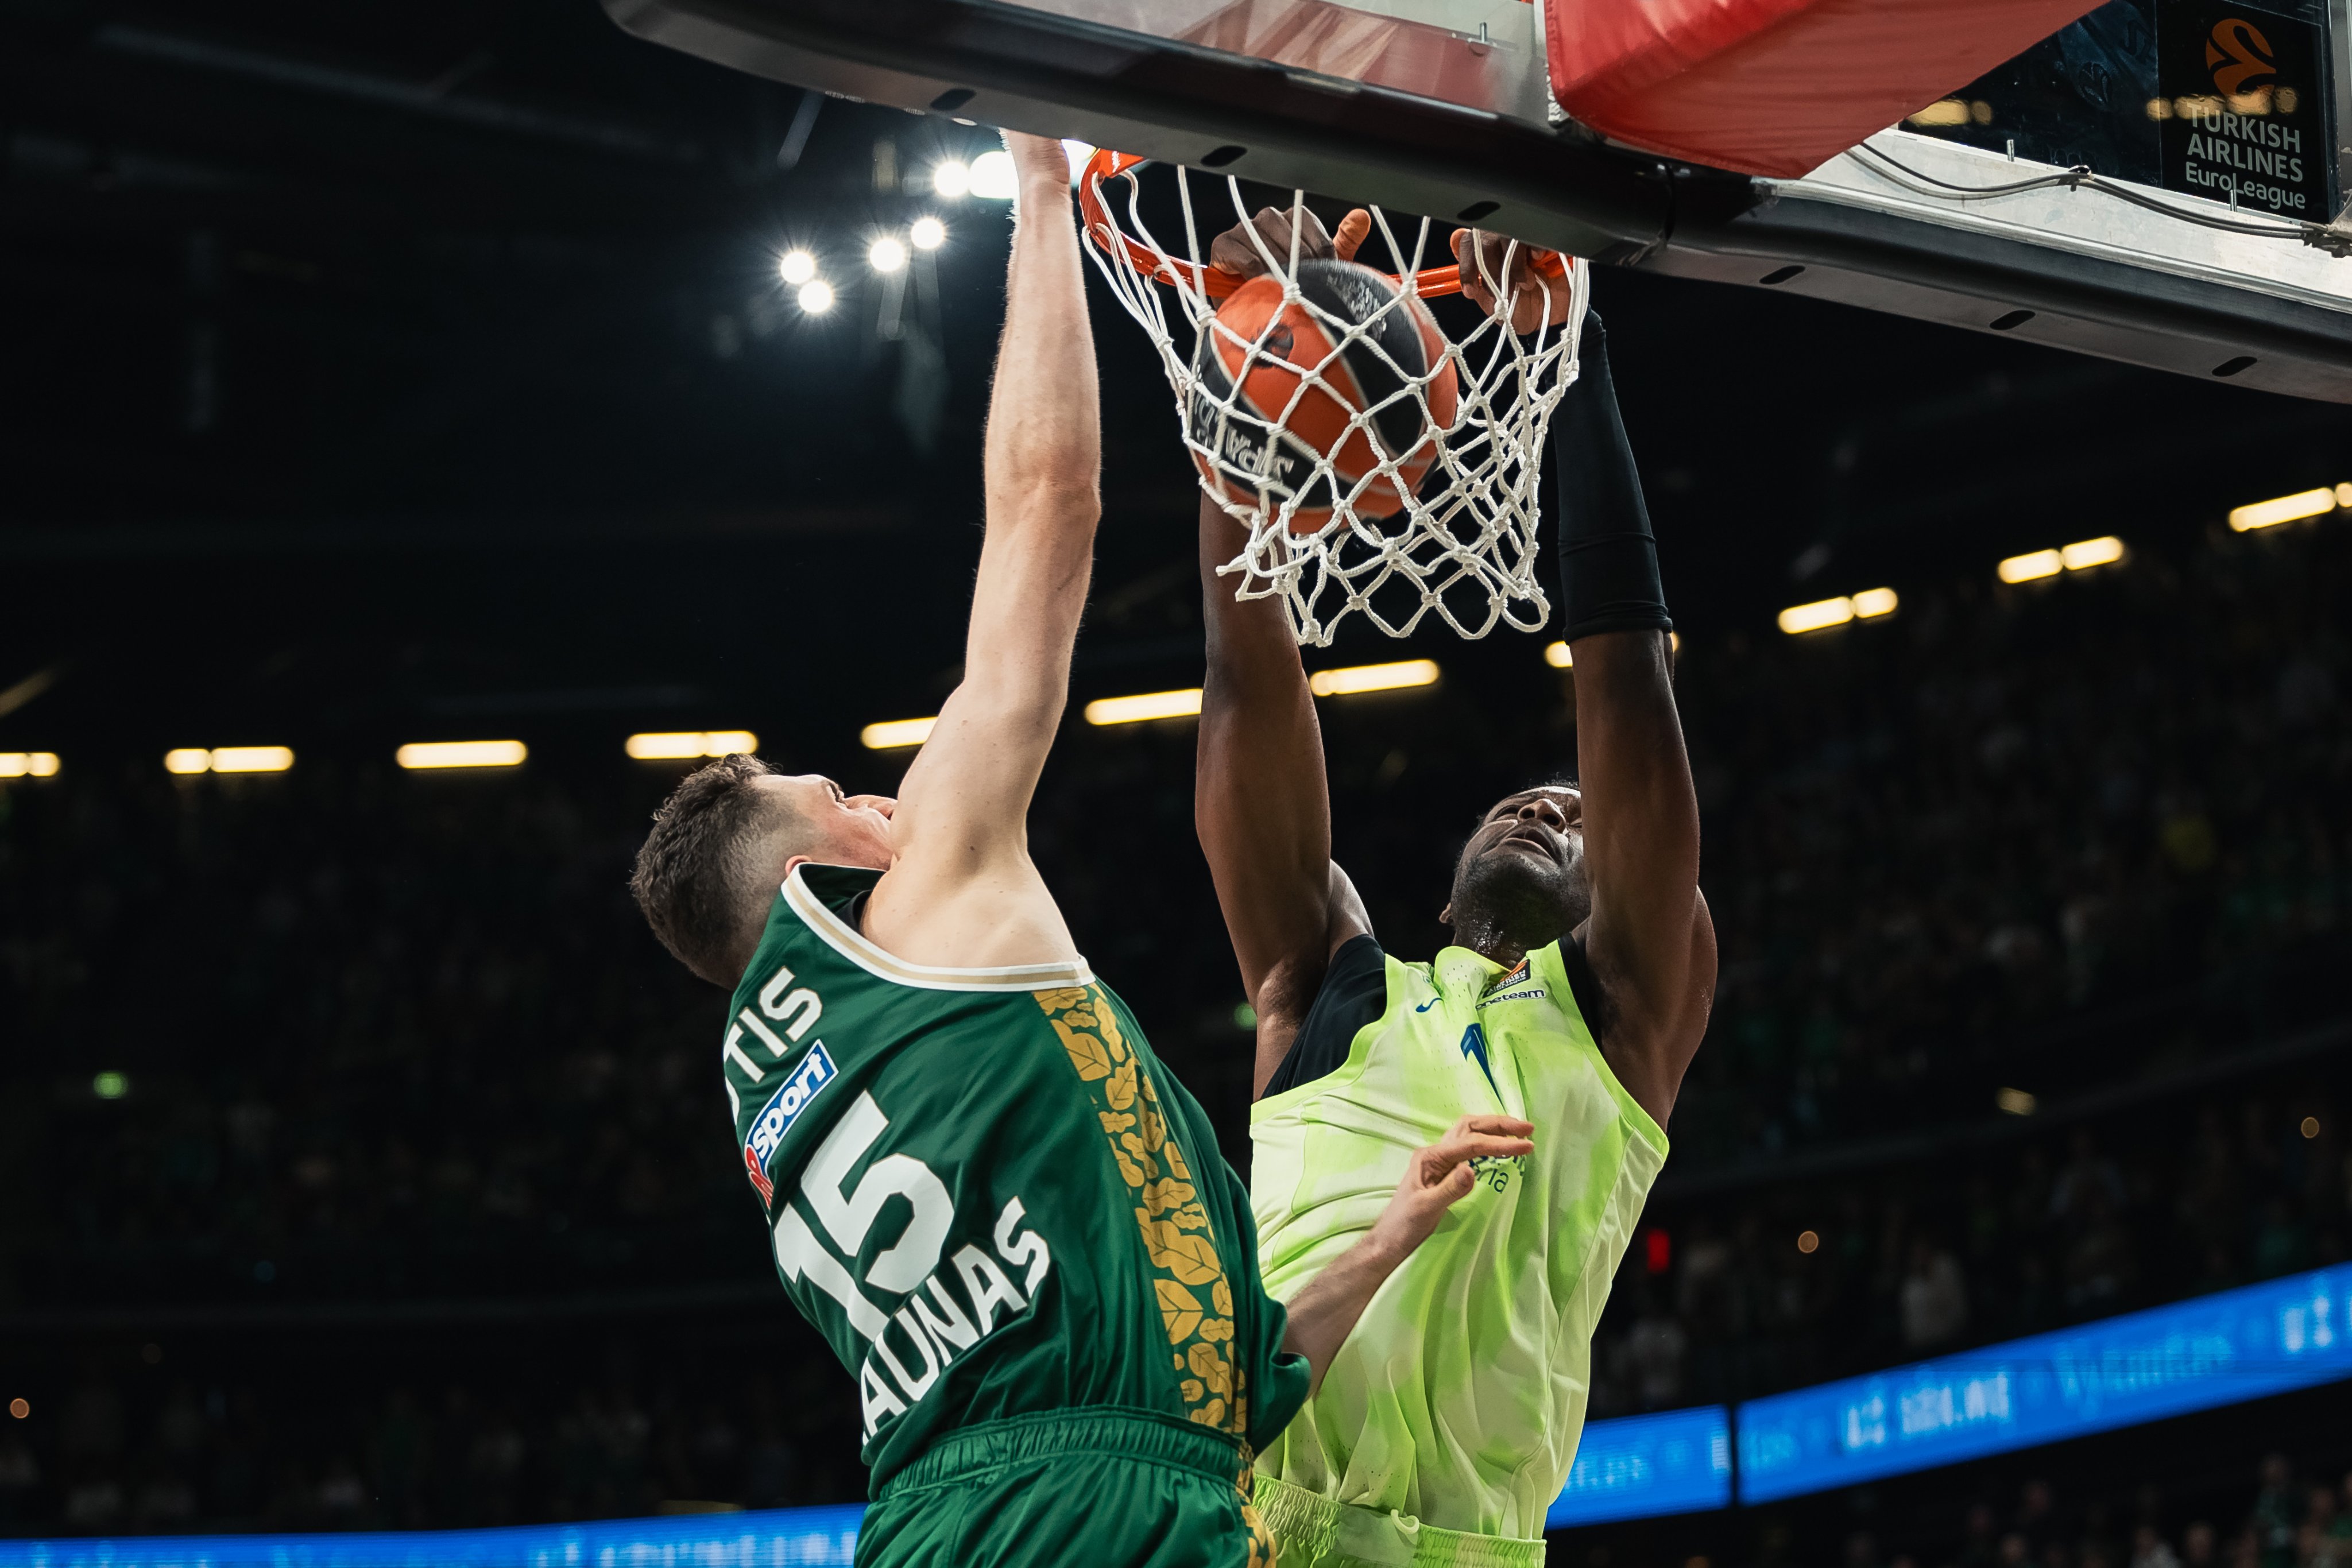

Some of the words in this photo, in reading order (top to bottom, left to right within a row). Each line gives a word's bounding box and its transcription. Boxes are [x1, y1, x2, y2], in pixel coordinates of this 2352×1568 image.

[2187, 102, 2300, 153] TURKISH
[2187, 133, 2303, 182] AIRLINES
[2185, 161, 2305, 210] EuroLeague
[724, 965, 822, 1126] TIS
[773, 1089, 954, 1342] 15
[861, 1196, 1050, 1447] AUNAS
